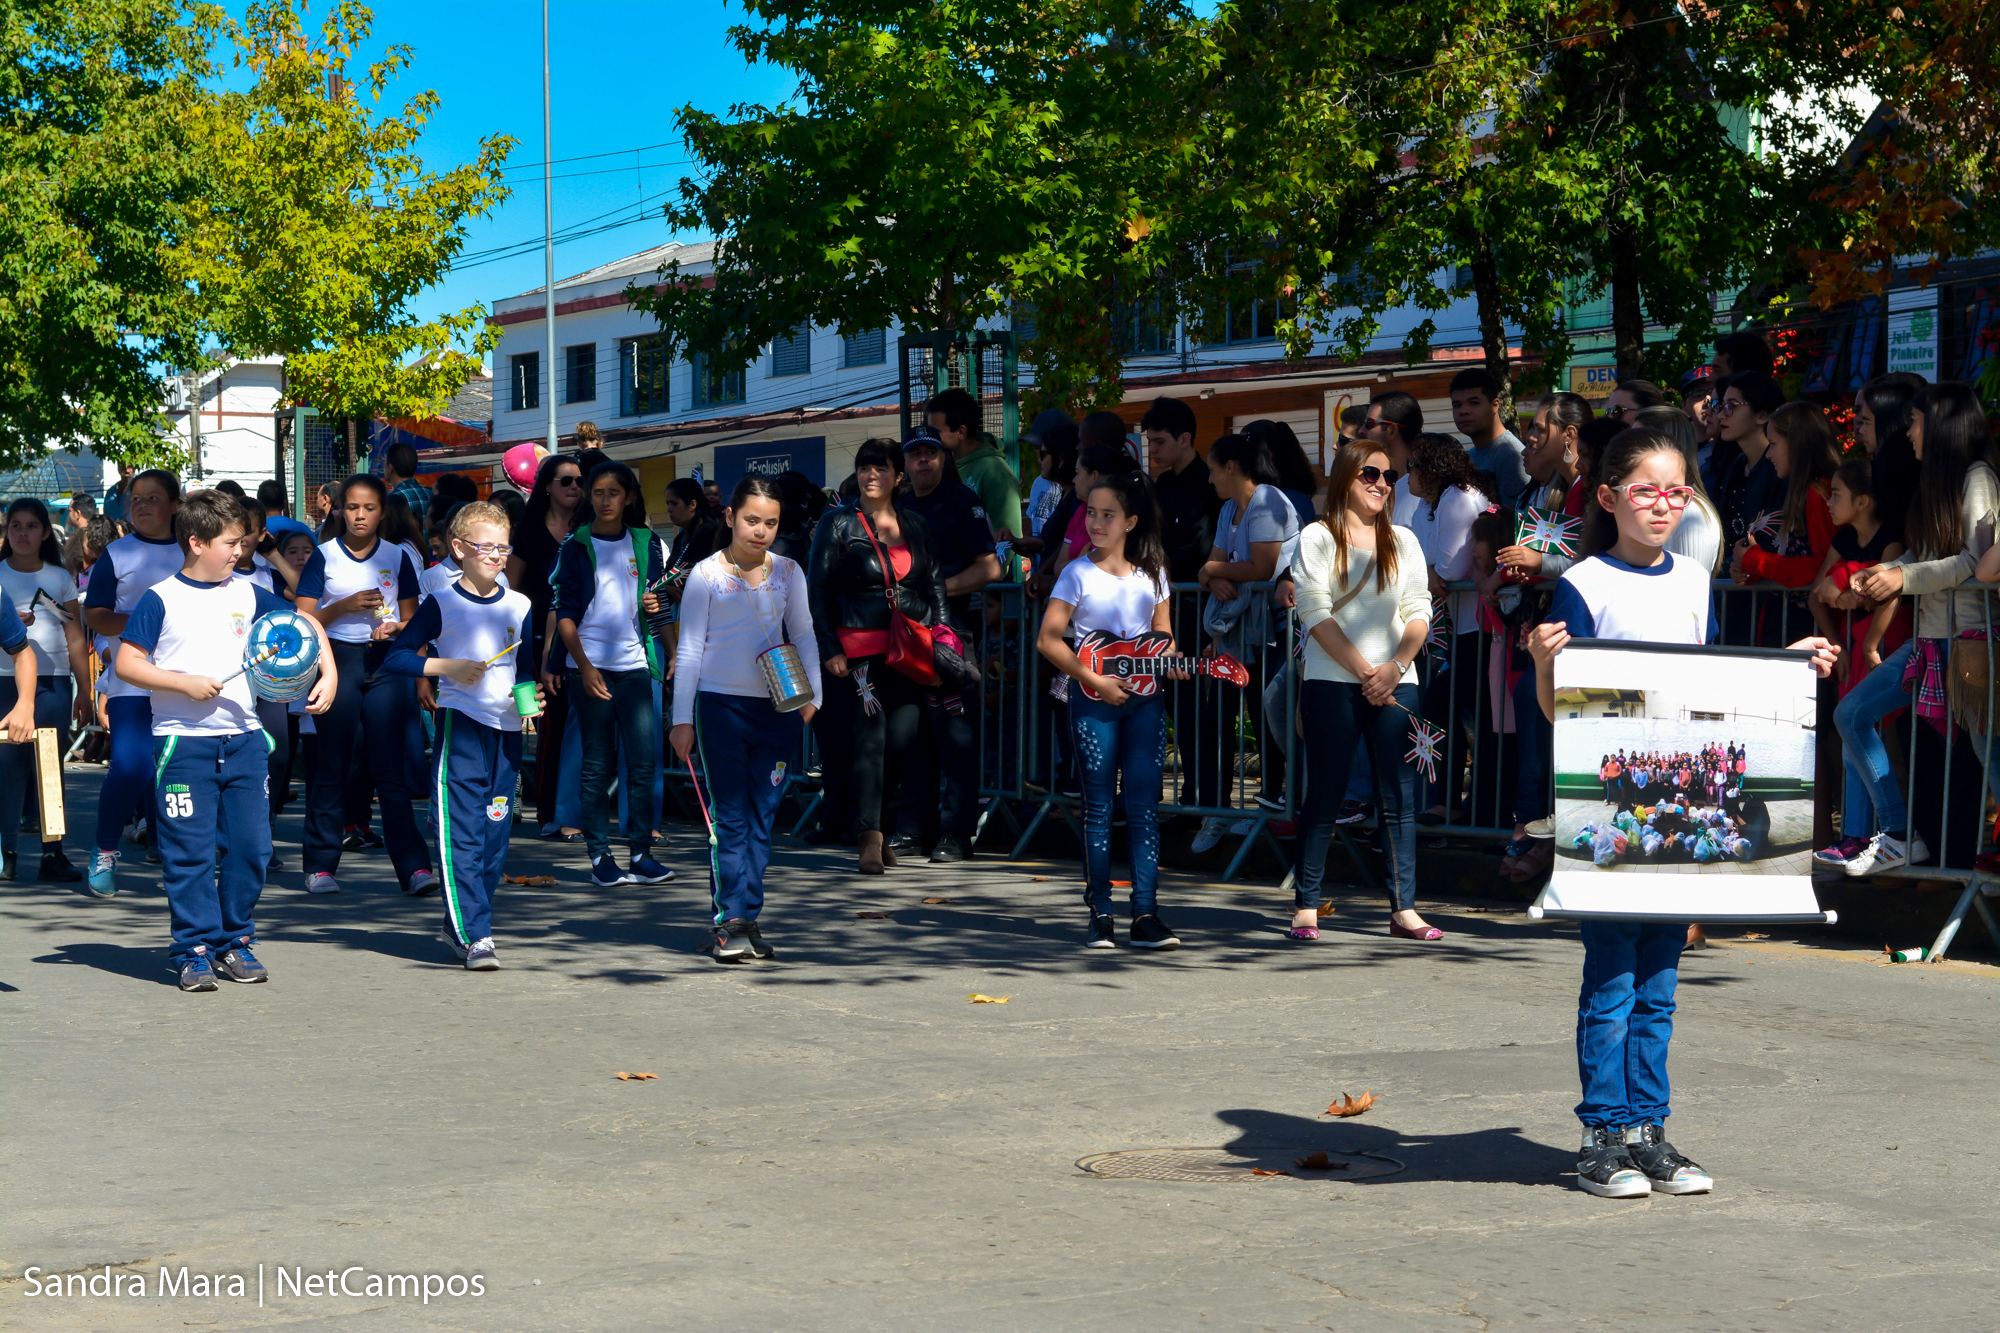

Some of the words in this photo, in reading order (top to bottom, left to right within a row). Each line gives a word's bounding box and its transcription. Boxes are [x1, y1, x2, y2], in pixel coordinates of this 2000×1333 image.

[1891, 330, 1911, 344] Jair
[1890, 346, 1934, 361] Pinheiro
[165, 792, 194, 818] 35
